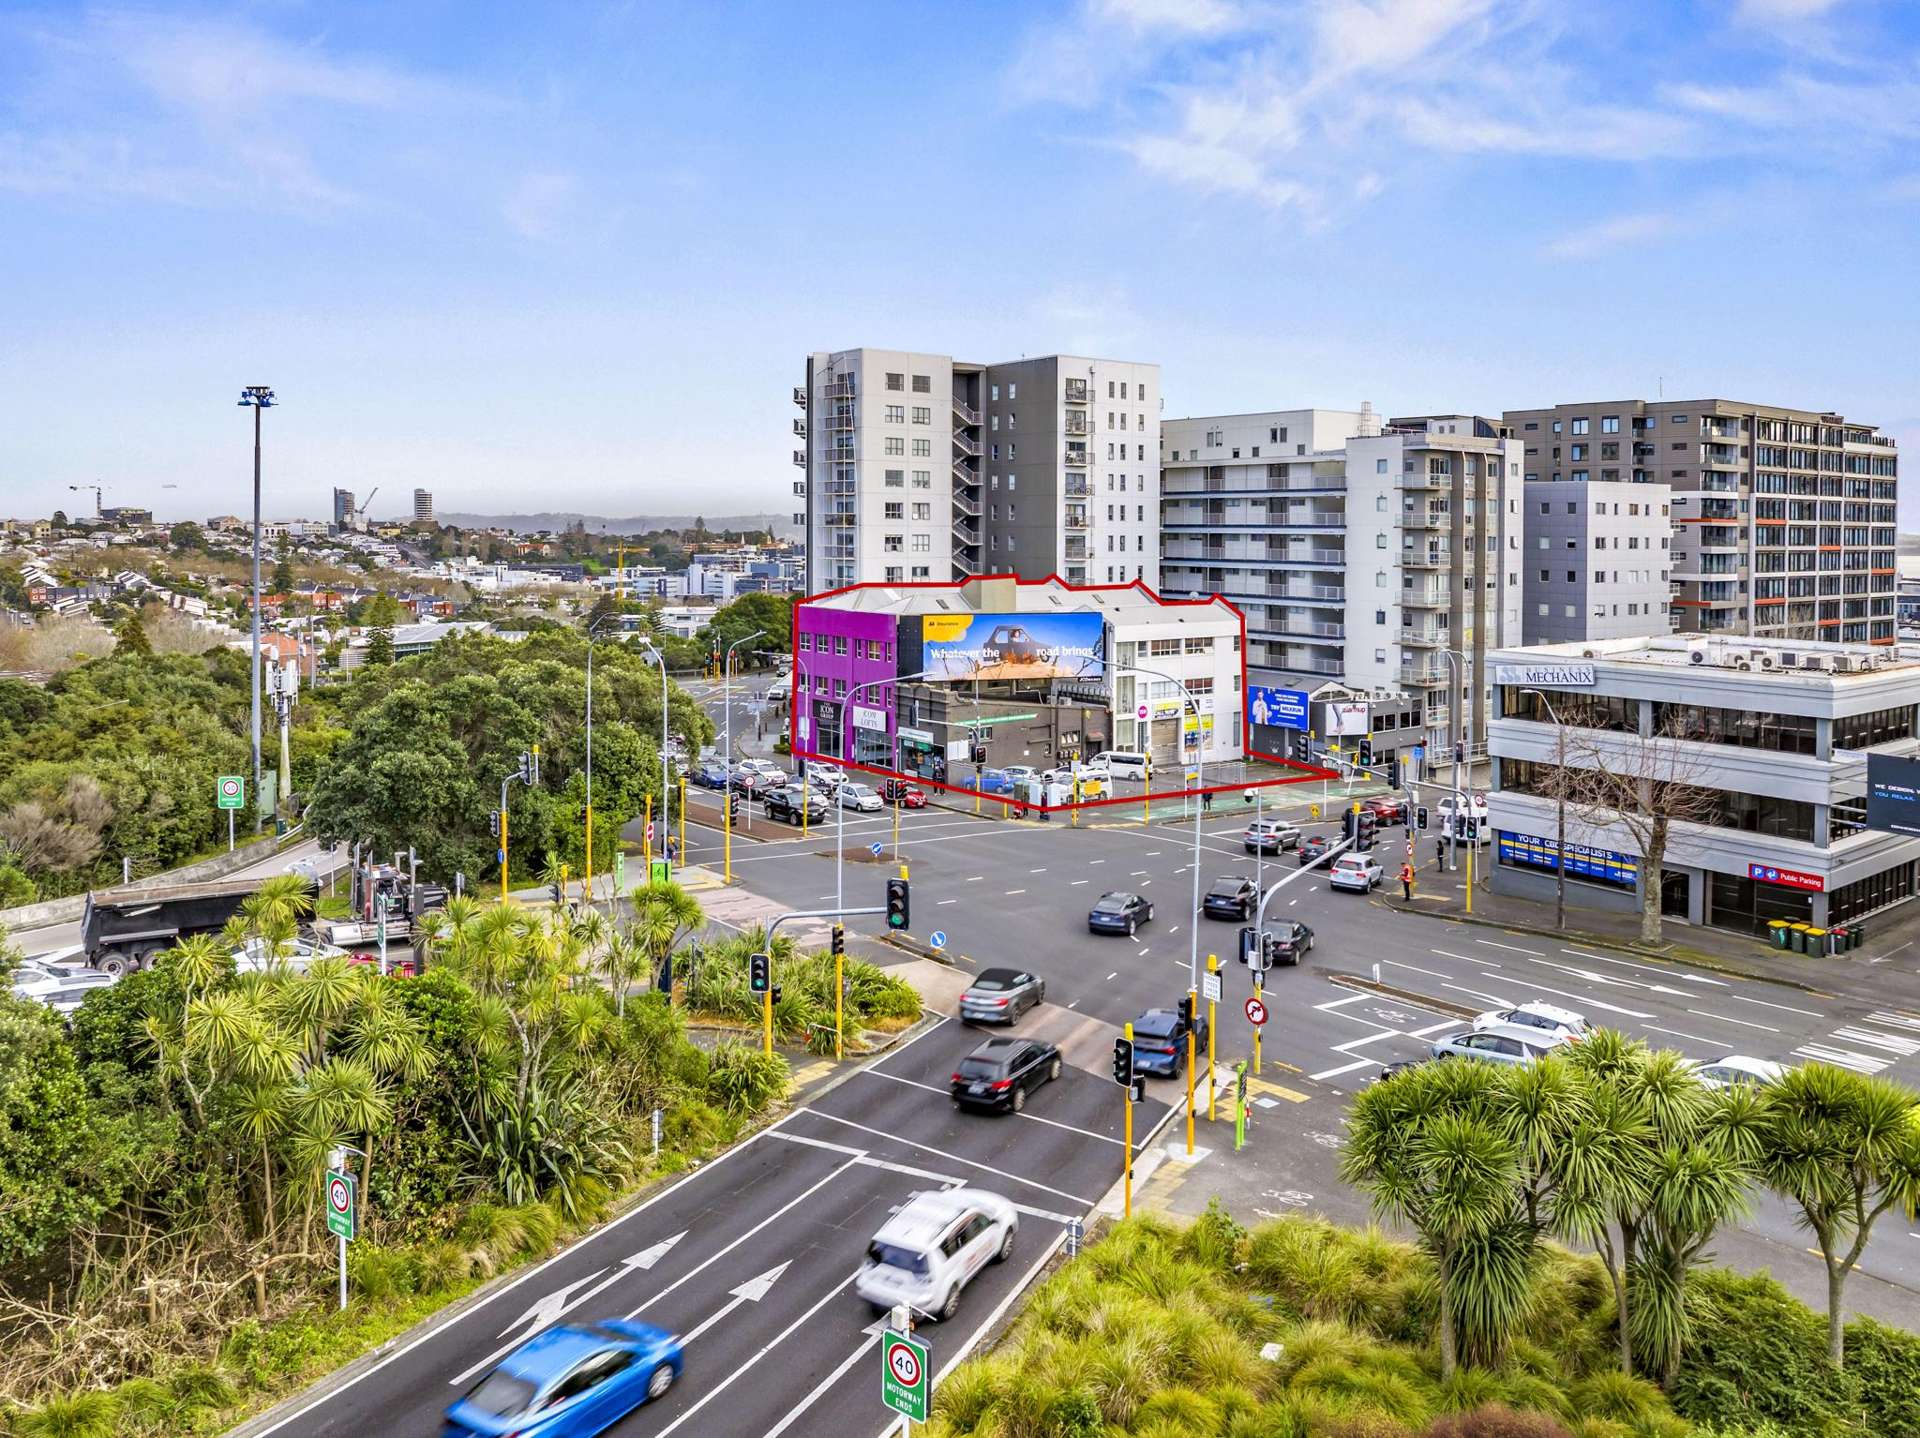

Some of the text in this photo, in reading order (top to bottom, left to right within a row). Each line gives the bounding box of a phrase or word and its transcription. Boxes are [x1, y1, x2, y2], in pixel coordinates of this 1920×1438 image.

[931, 648, 979, 659] Whatever
[983, 647, 1000, 658] the
[1036, 647, 1059, 657] road
[1526, 672, 1592, 683] MECHANIX
[820, 705, 835, 714] ICON
[1518, 834, 1540, 845] YOUR
[1564, 844, 1613, 859] SPECIALISTS
[1780, 873, 1798, 882] Public
[1800, 876, 1821, 888] Parking
[334, 1190, 344, 1203] 40
[896, 1356, 913, 1375] 40
[887, 1382, 921, 1406] MOTORWAY
[895, 1398, 913, 1413] ENDS
